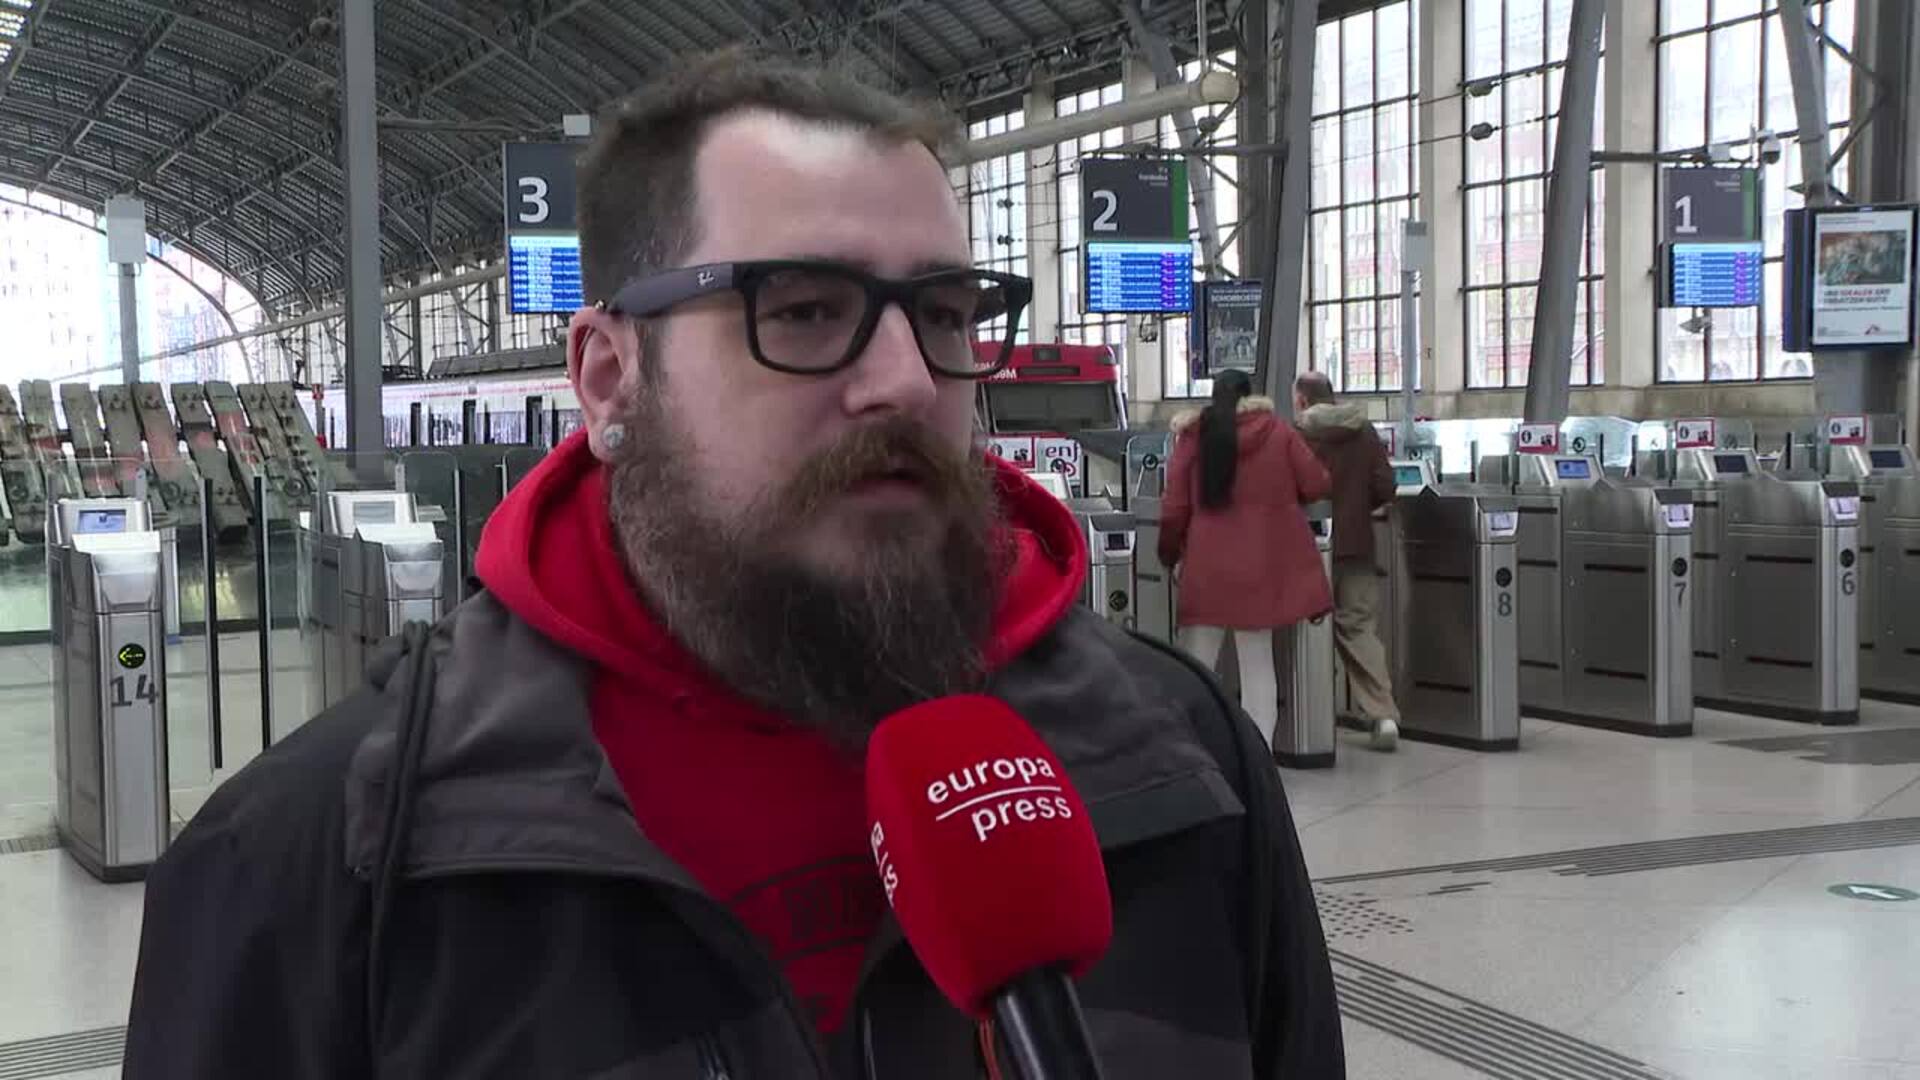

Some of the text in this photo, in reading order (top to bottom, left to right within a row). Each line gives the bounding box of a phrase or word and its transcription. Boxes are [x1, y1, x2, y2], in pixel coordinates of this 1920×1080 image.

[517, 176, 550, 224] 3
[1091, 189, 1119, 232] 2
[1674, 195, 1698, 233] 1
[1673, 582, 1688, 609] 7
[1841, 571, 1855, 596] 6
[1496, 591, 1512, 618] 8
[110, 674, 159, 708] 14
[926, 755, 1056, 804] europa
[971, 797, 1072, 843] press
